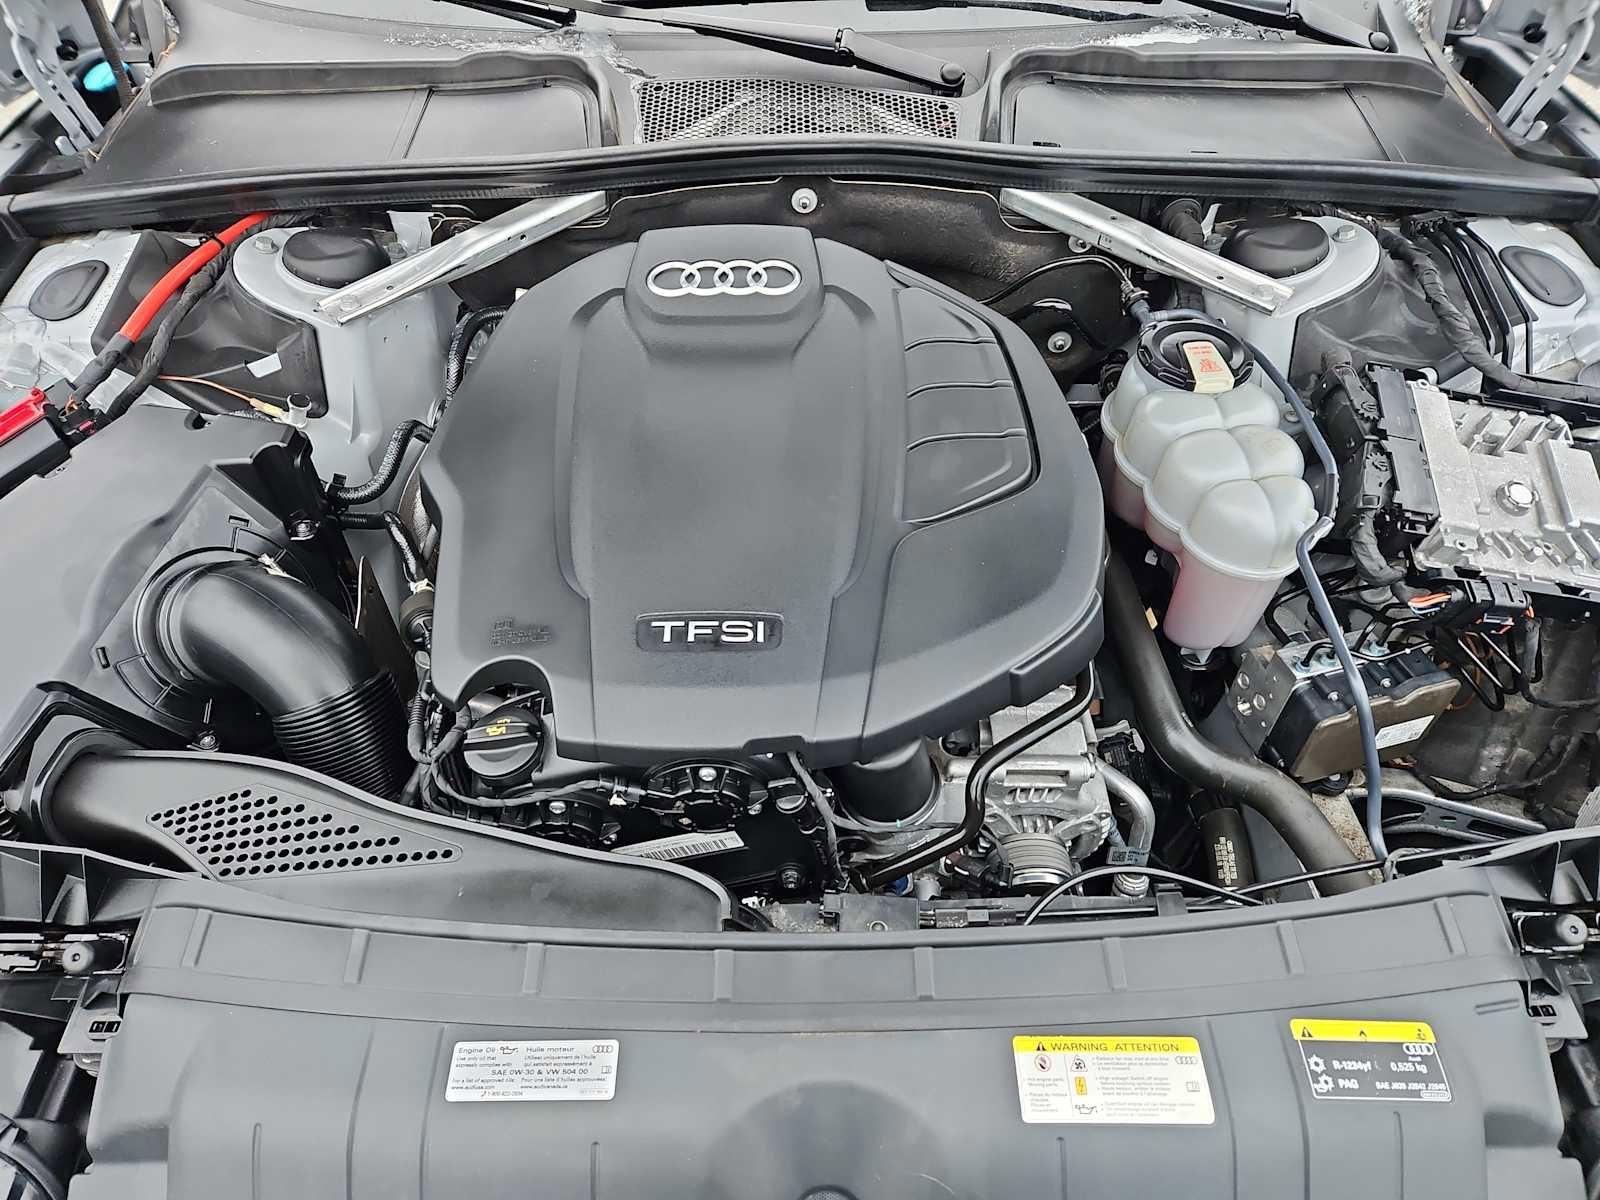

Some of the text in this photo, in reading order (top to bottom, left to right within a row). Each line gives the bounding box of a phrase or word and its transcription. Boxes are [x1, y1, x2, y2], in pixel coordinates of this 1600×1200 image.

[651, 620, 765, 643] TFSI
[458, 1047, 484, 1055] Engine
[1051, 1043, 1180, 1052] WARNING ATTENTION
[1390, 1061, 1428, 1074] 0,525 kg
[1338, 1078, 1360, 1089] PAG
[1375, 1081, 1390, 1090] SAE
